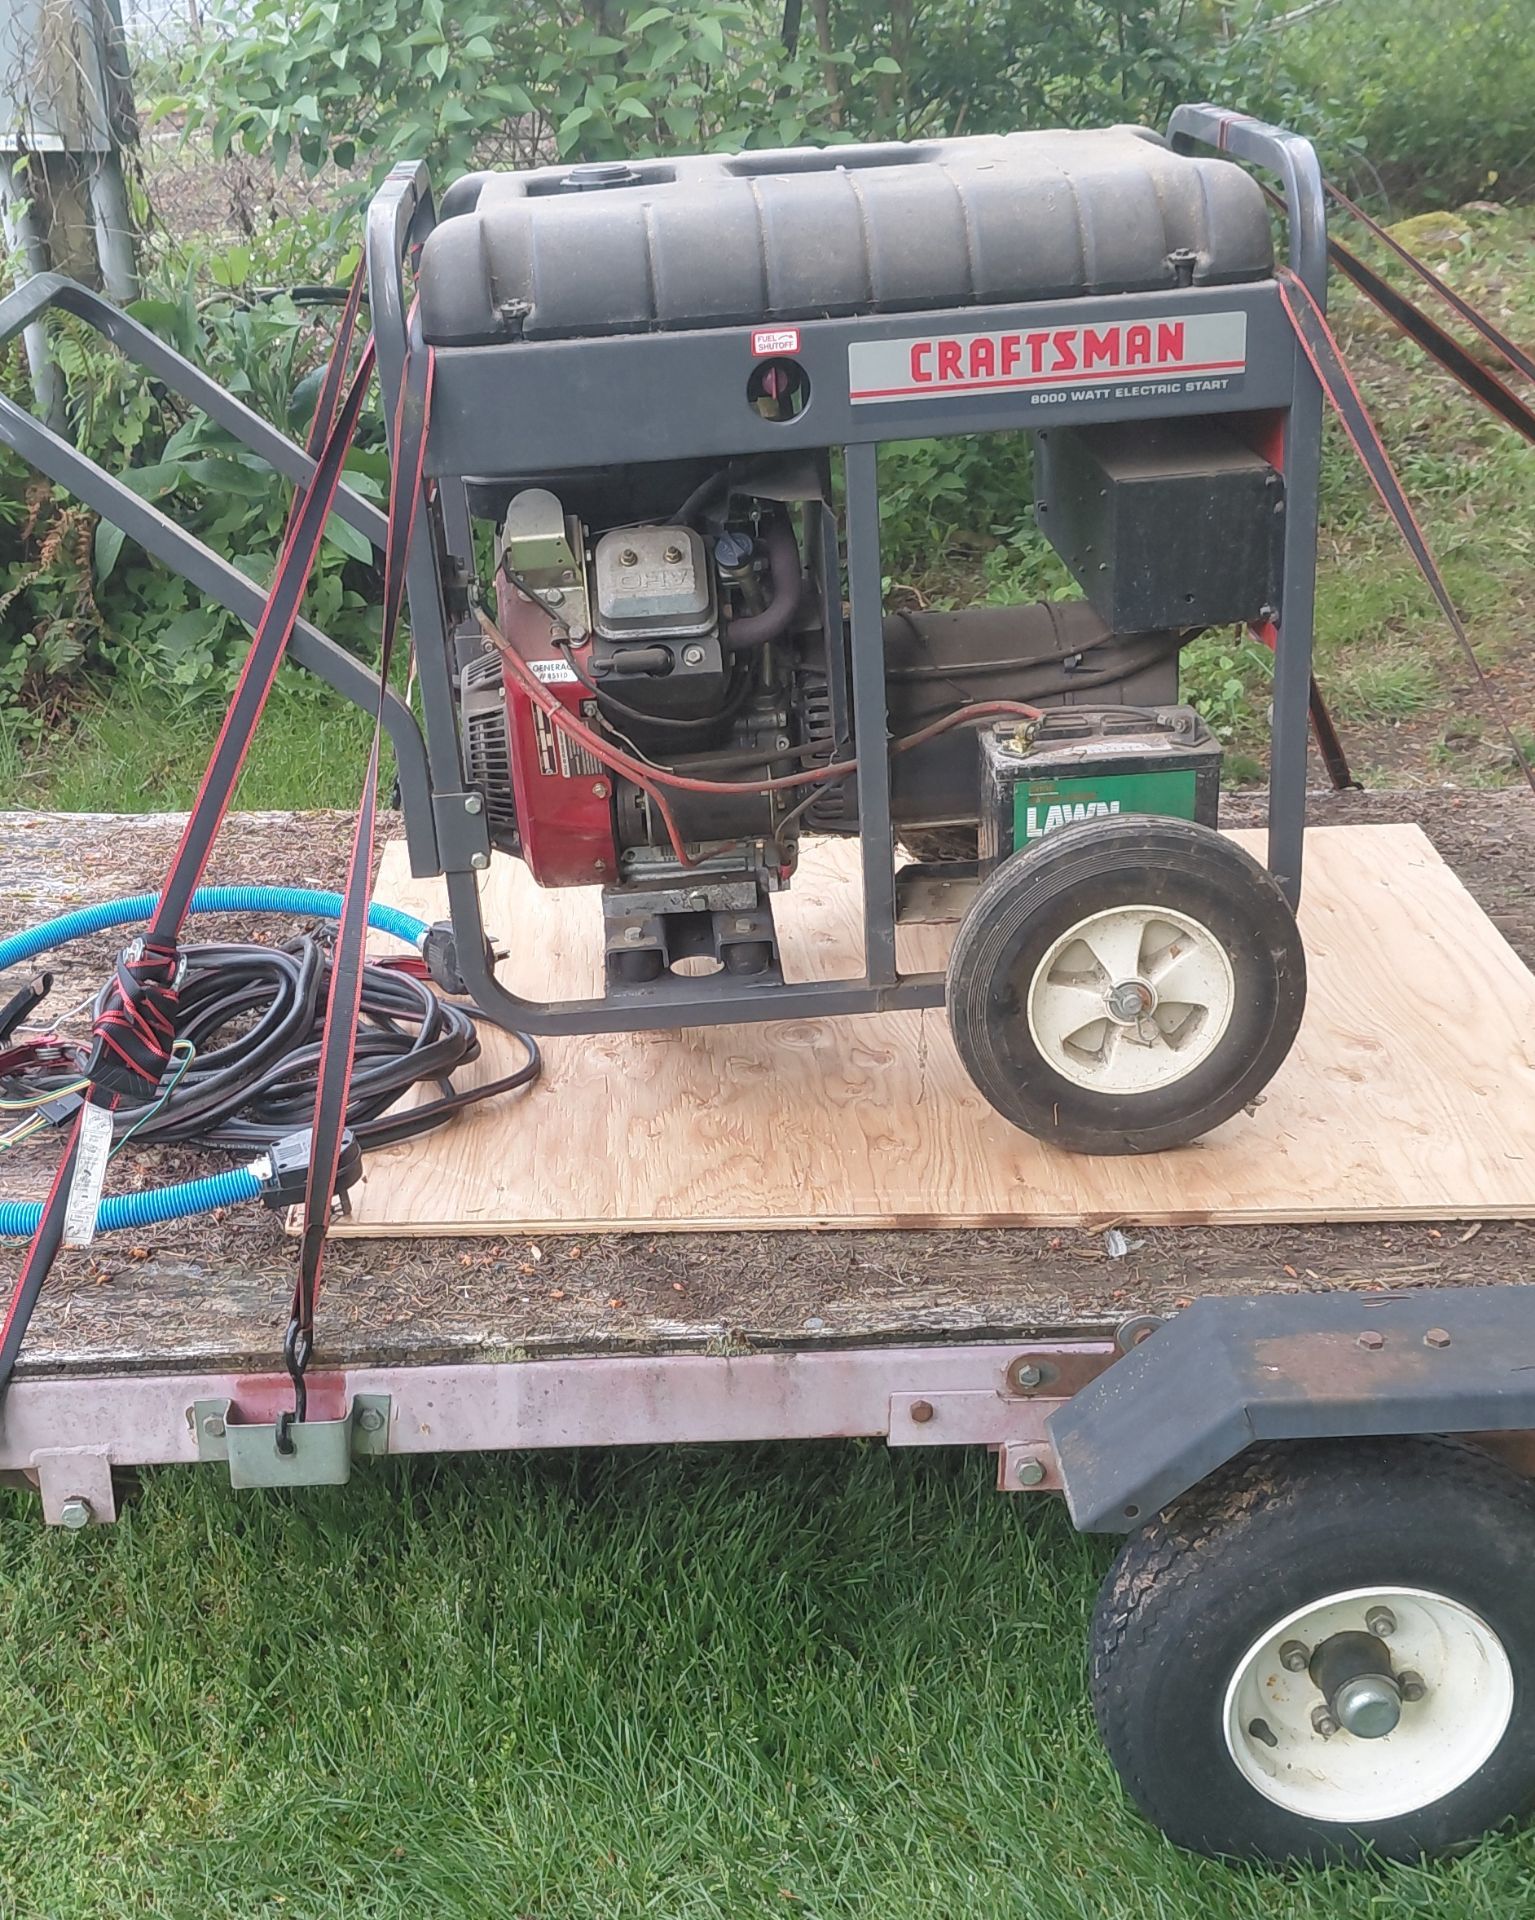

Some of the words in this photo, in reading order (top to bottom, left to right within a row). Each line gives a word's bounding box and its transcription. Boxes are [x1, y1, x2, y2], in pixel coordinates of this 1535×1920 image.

[757, 335, 777, 343] FUEL
[758, 341, 794, 351] SHUTOFF
[911, 322, 1184, 382] CRAFTSMAN
[1030, 393, 1067, 404] 8000
[1071, 389, 1111, 401] WATT
[1115, 383, 1182, 398] ELECTRIC
[1185, 379, 1230, 392] START
[532, 663, 573, 673] GENERAC
